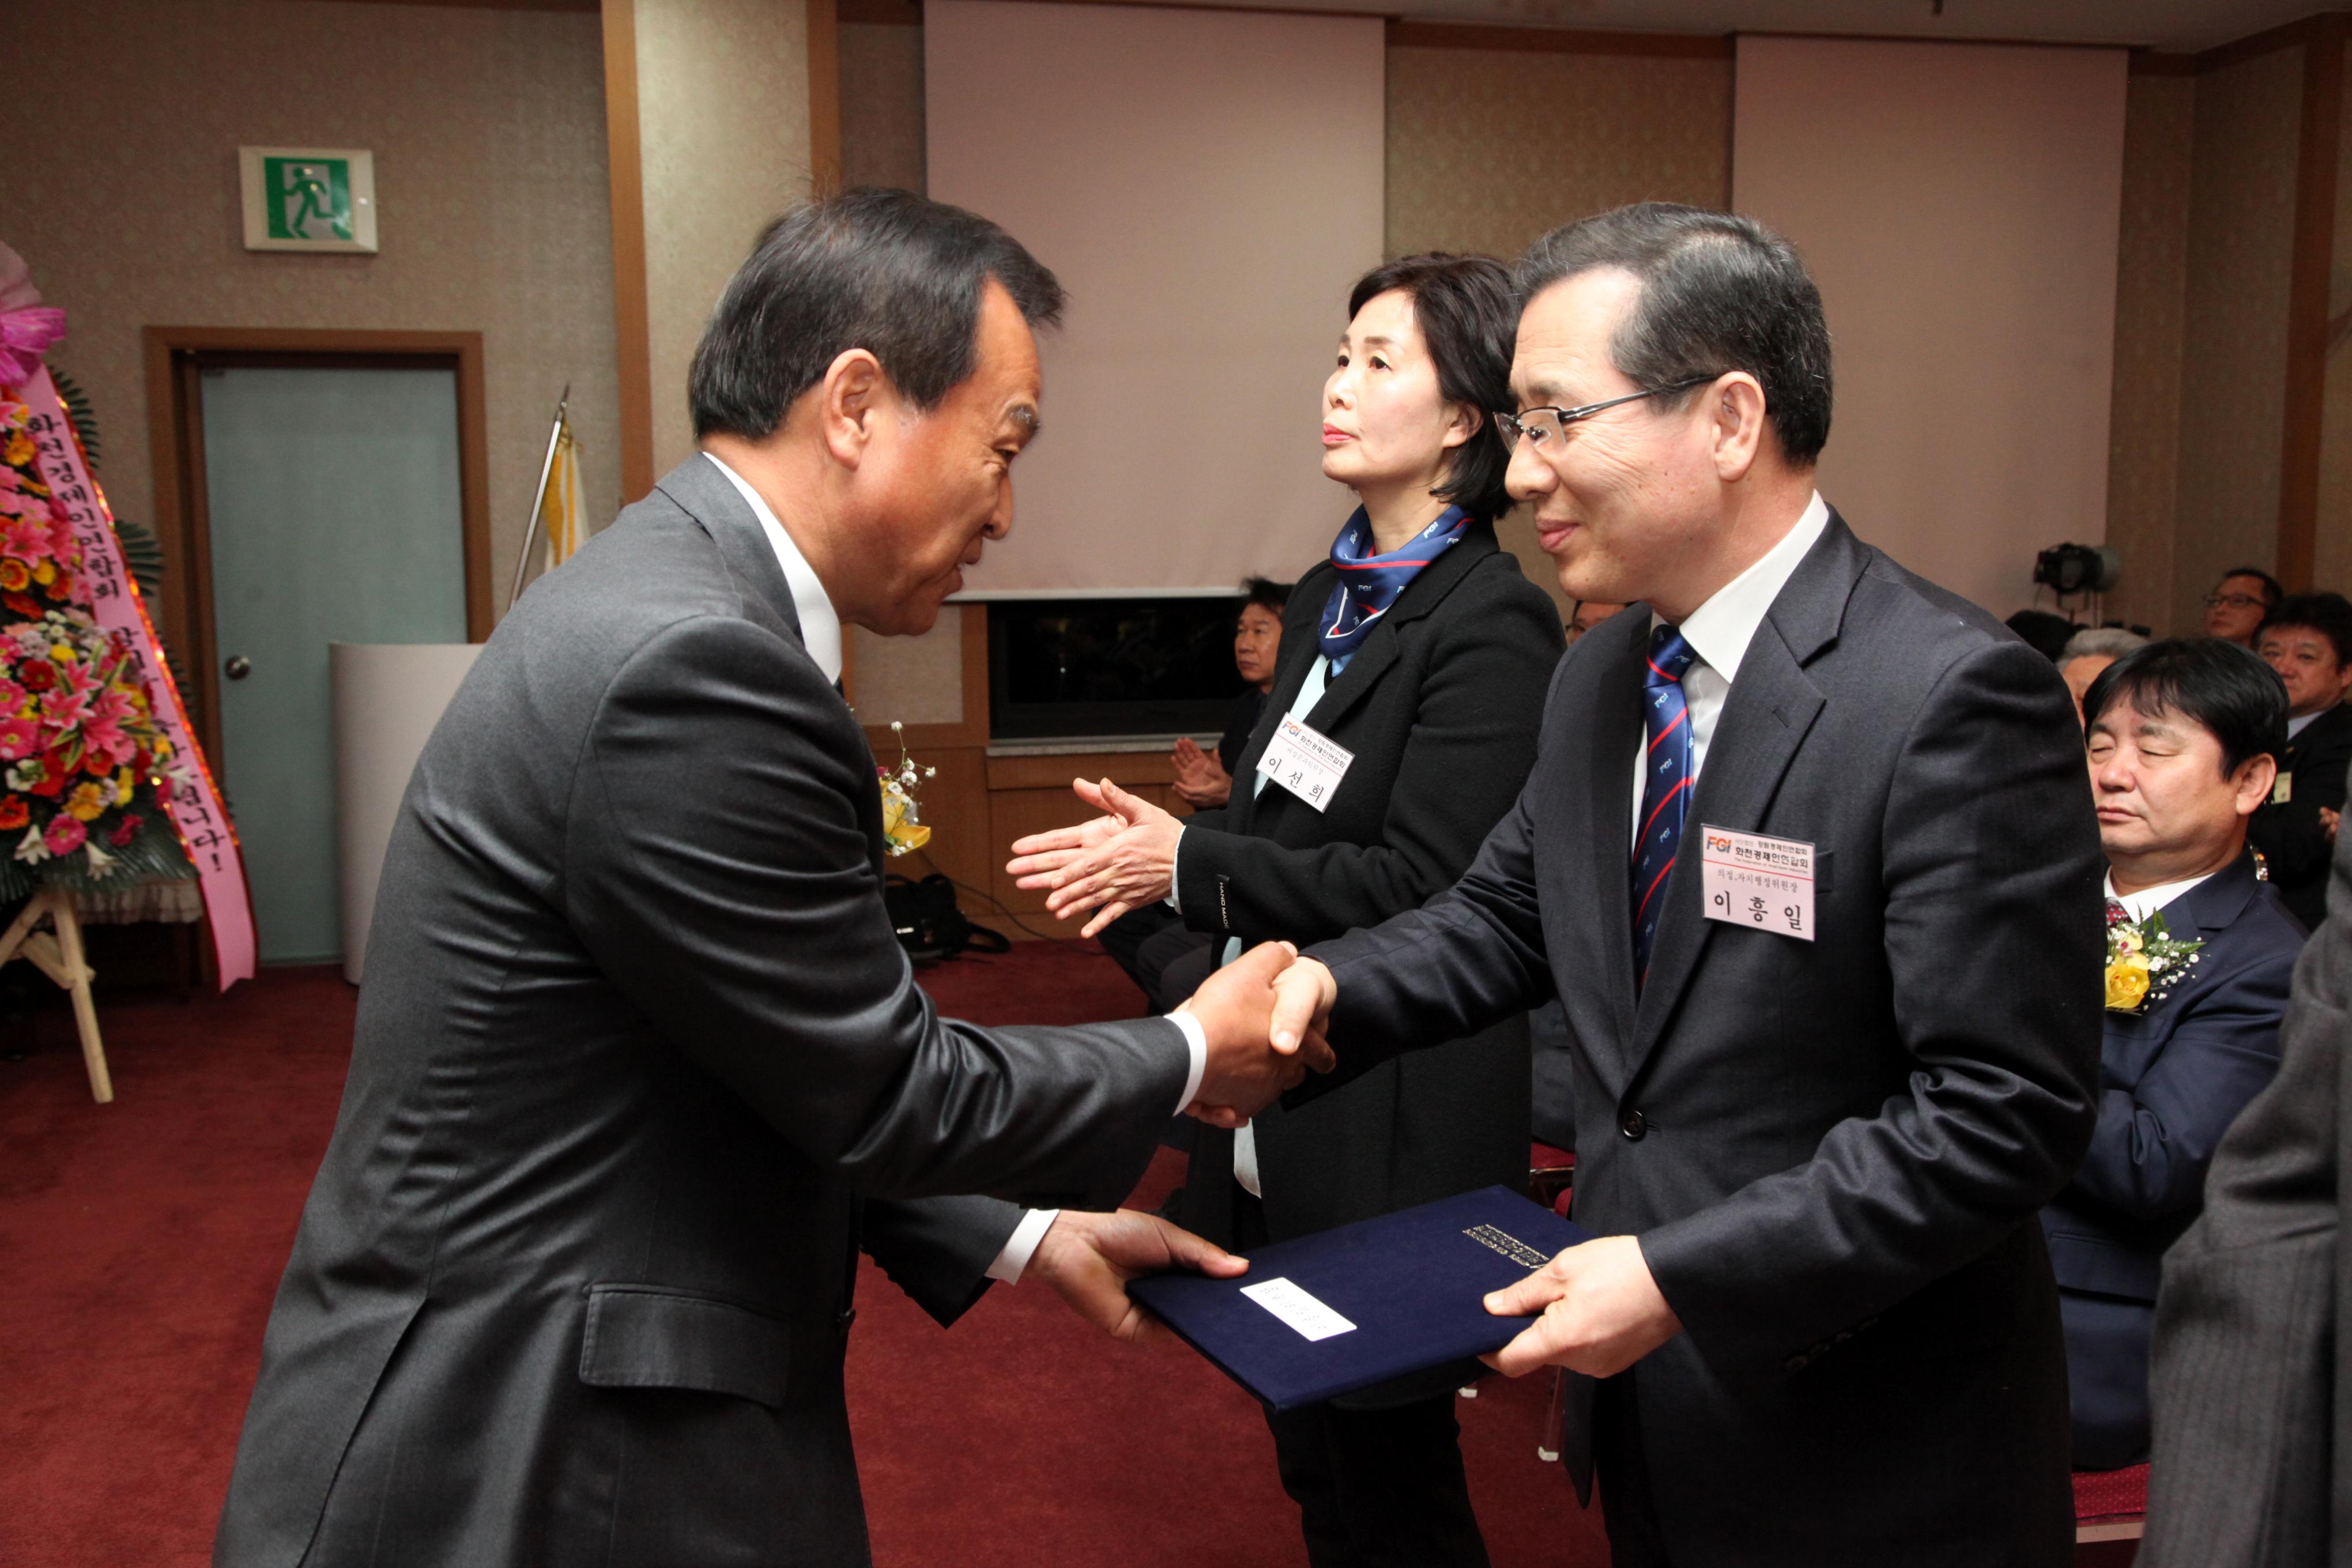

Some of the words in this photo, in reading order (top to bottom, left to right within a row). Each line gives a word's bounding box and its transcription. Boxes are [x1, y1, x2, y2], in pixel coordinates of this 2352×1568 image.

[1423, 521, 1438, 539] FGI
[1654, 692, 1668, 708] FGI
[1282, 721, 1302, 737] FGI
[1301, 736, 1345, 768] 화천경제인연합회
[1660, 759, 1672, 774] FGI
[1706, 836, 1732, 853] FGI
[1758, 841, 1807, 855] 강원경제인연합회
[1735, 847, 1808, 868] 화천경제인연합회
[1222, 907, 1230, 929] MADE
